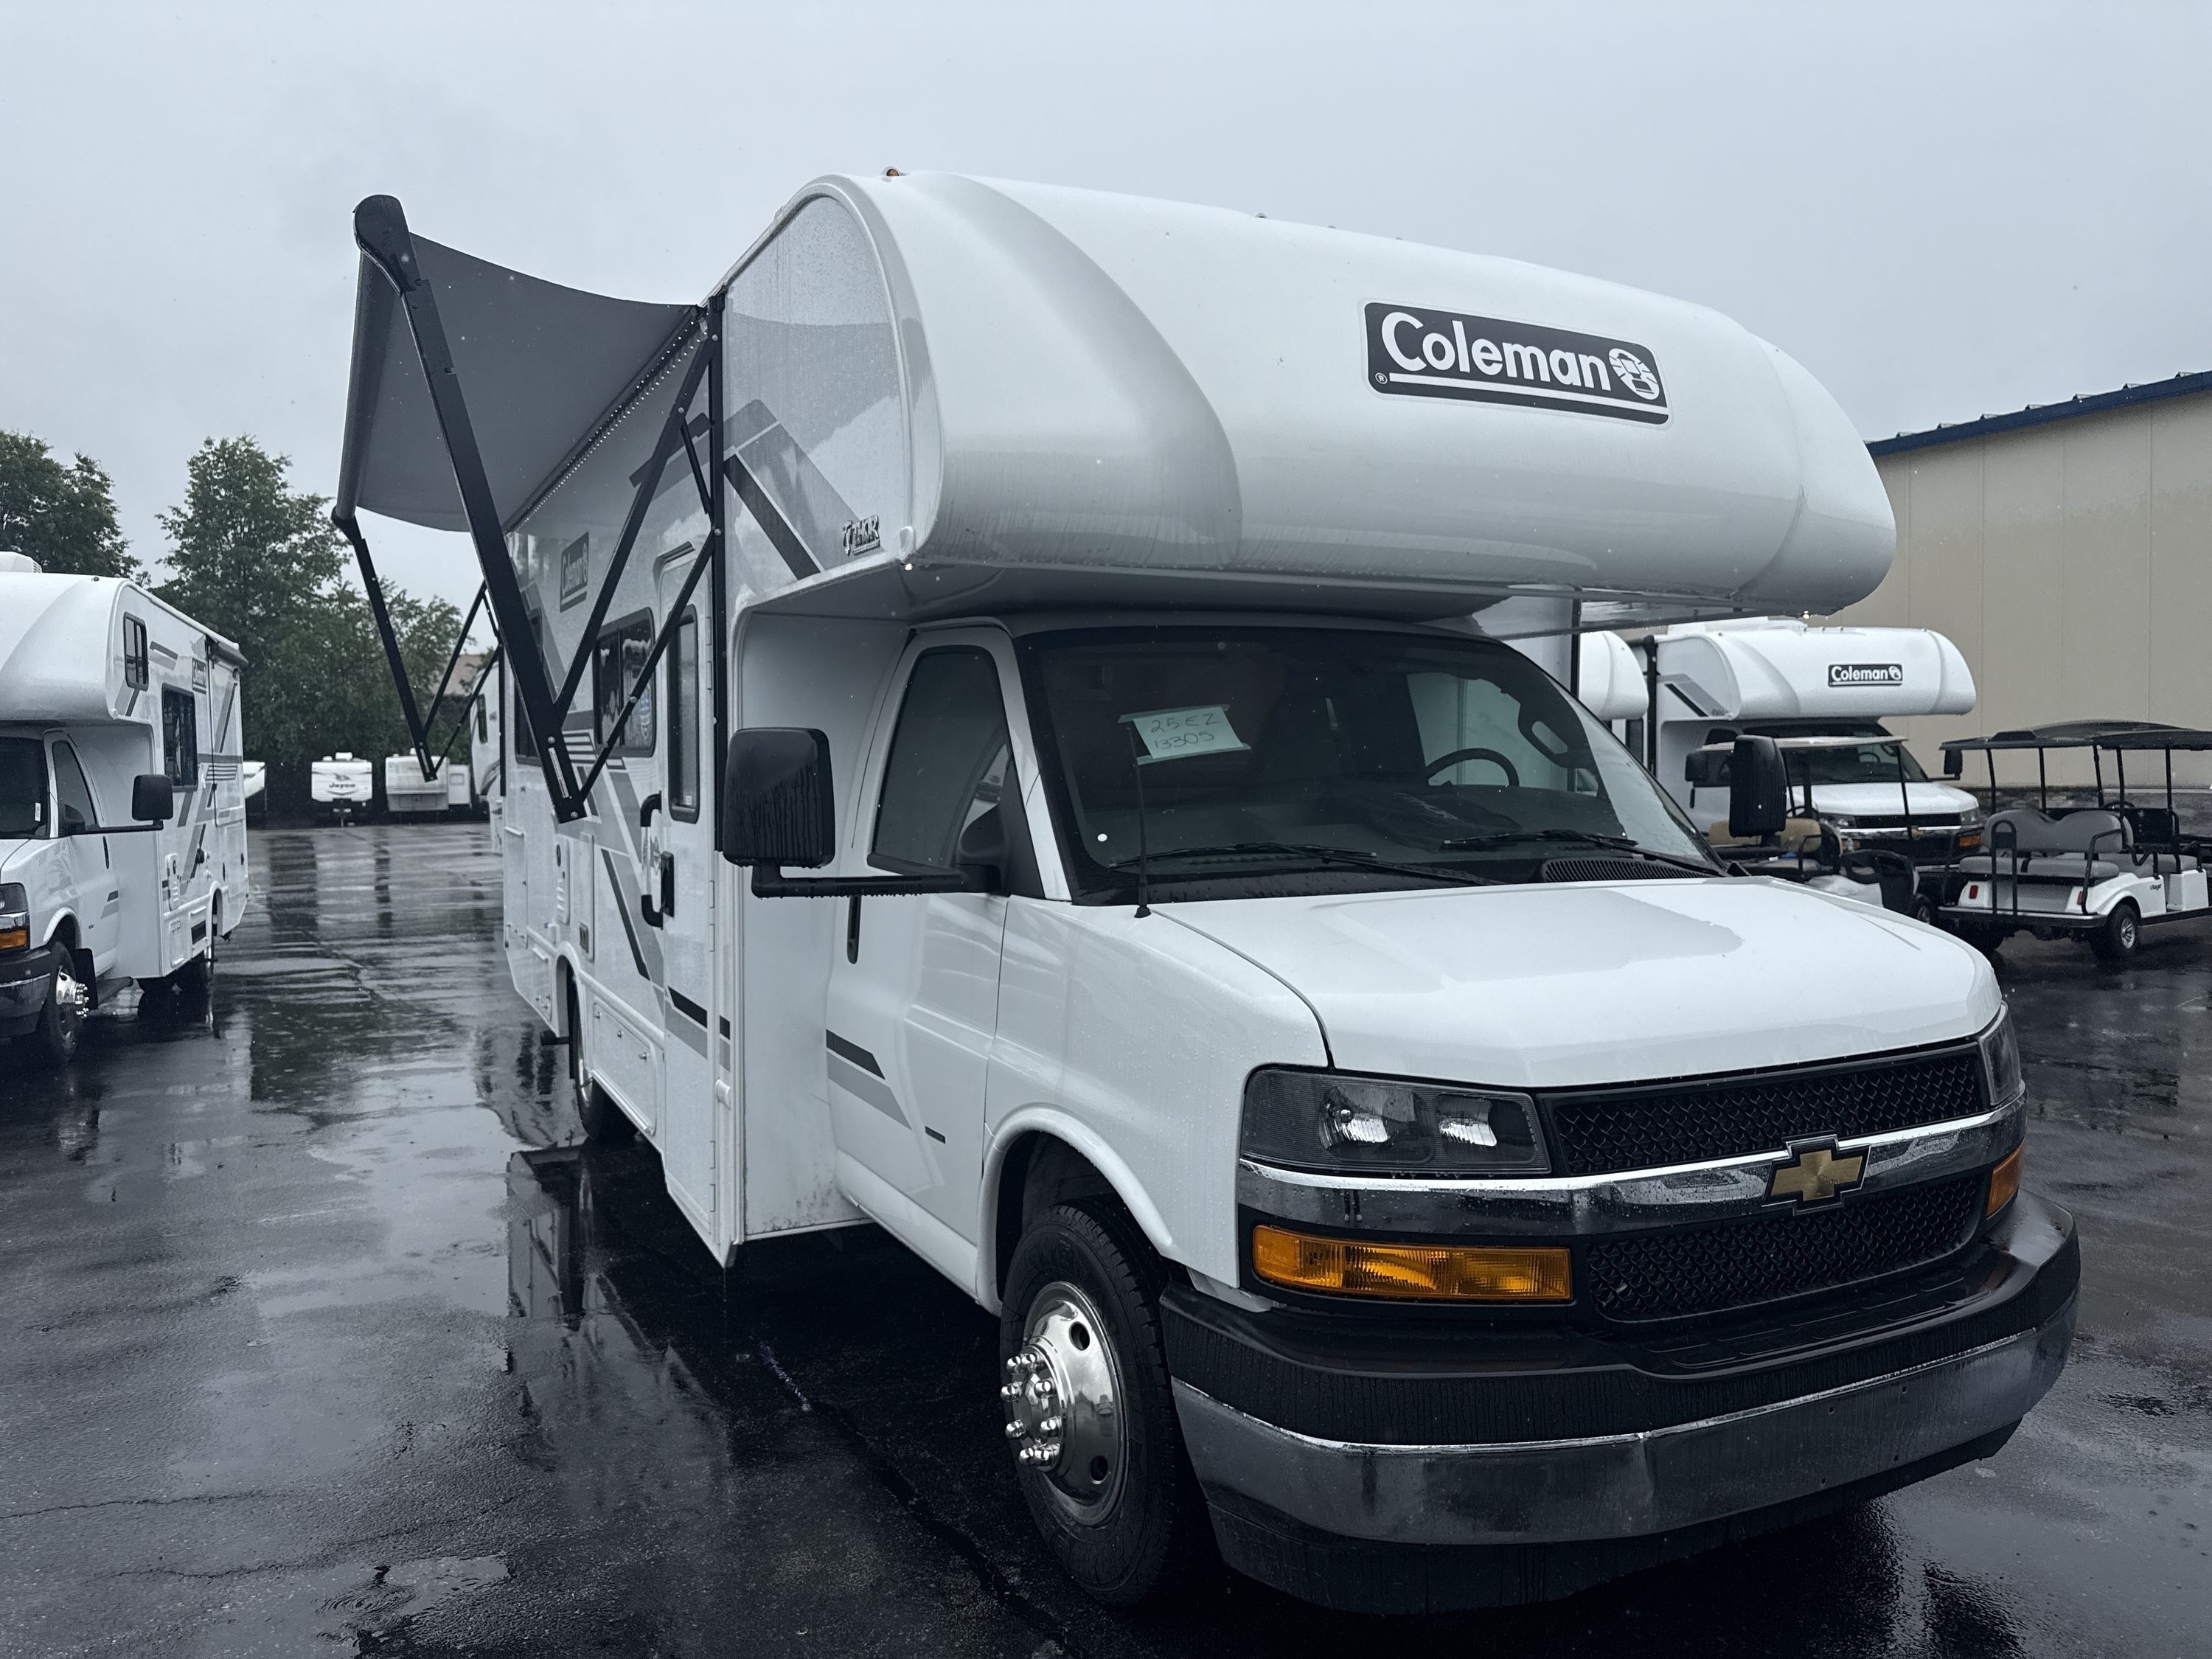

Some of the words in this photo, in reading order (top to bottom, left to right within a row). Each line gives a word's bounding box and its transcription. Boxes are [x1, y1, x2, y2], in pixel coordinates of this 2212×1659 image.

[1380, 311, 1612, 392] Coleman
[1831, 665, 1888, 681] Coleman
[1155, 731, 1214, 750] 13305
